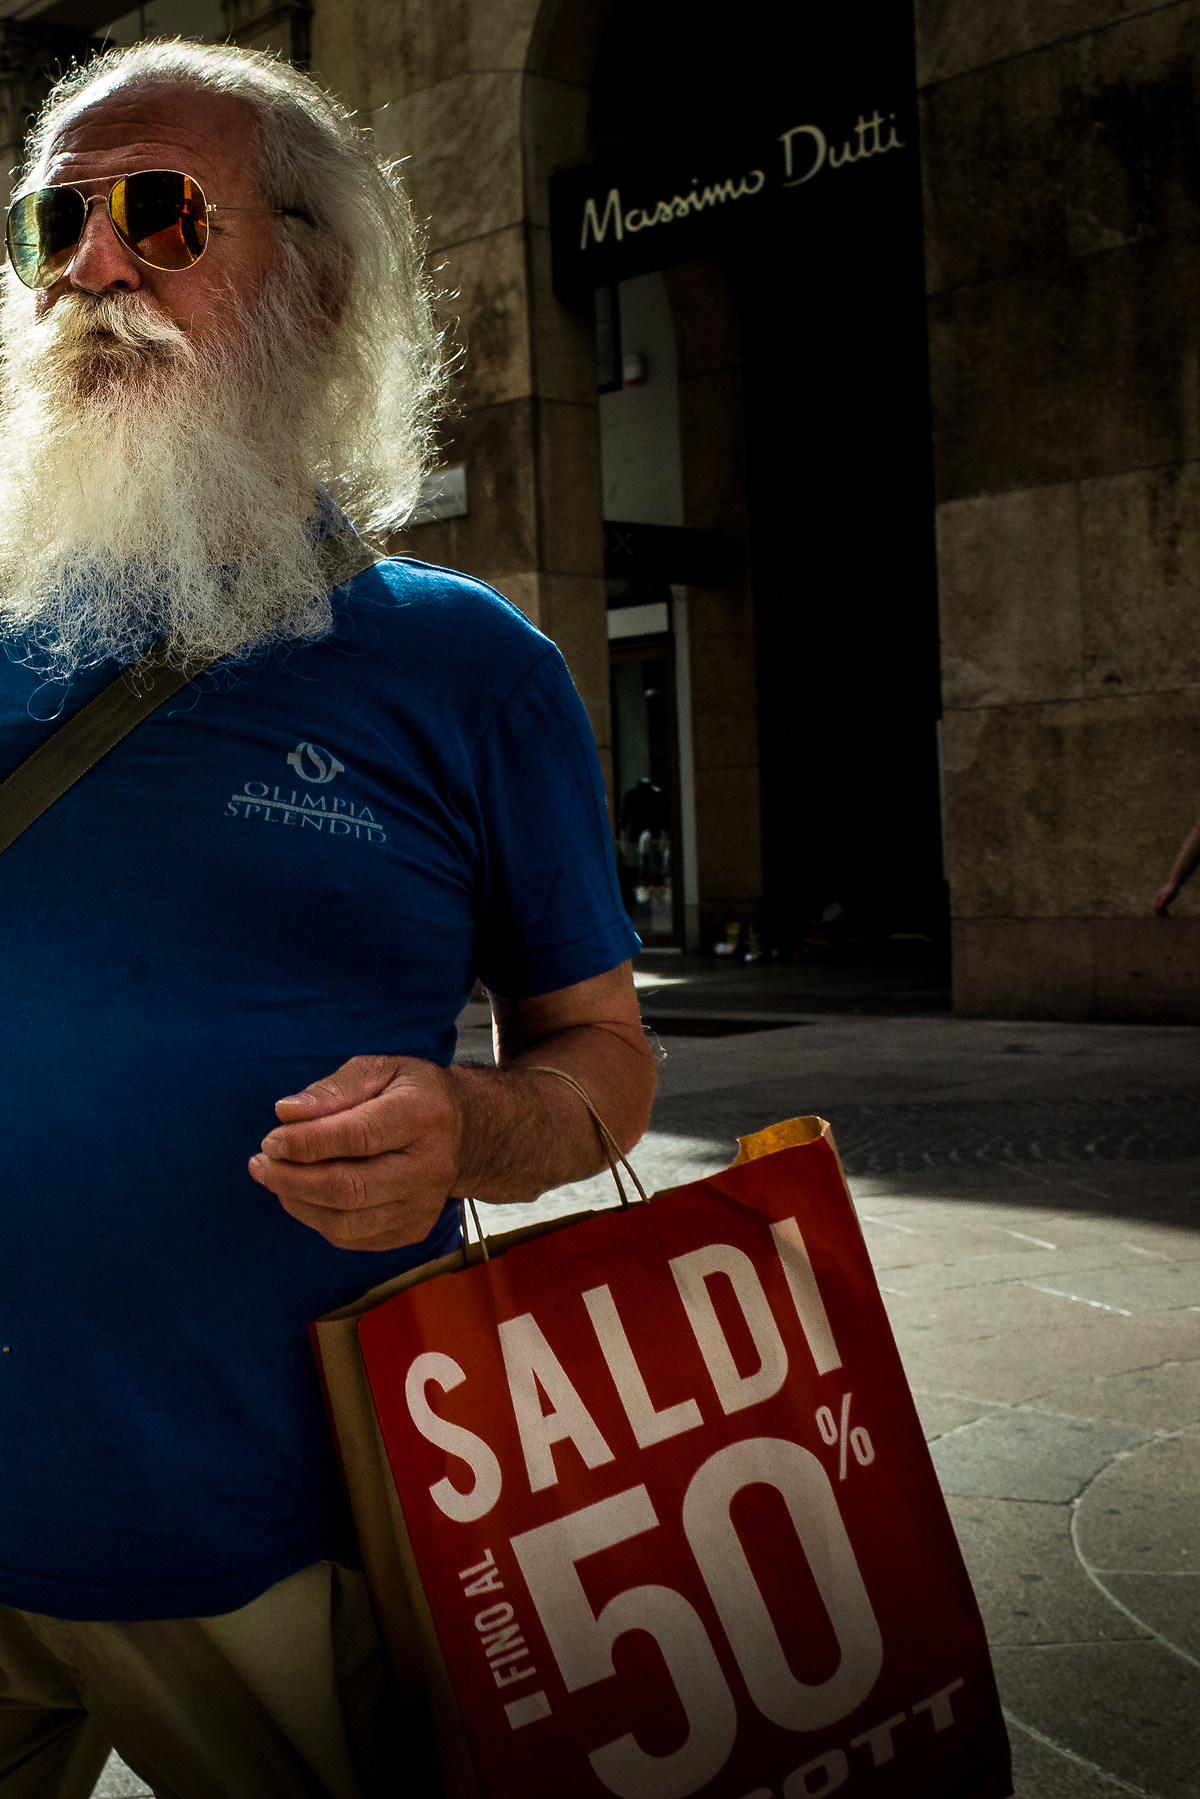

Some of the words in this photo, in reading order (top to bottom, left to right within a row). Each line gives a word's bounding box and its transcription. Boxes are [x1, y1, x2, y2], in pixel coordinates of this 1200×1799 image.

[579, 167, 766, 251] Massimo
[776, 108, 907, 188] Dutti
[224, 801, 388, 843] SPLENDID
[244, 781, 375, 822] OLIMPIA
[404, 1216, 843, 1523] SALDI
[458, 1547, 505, 1599] AL
[474, 1601, 537, 1690] FINO
[735, 1676, 965, 1799] OTT
